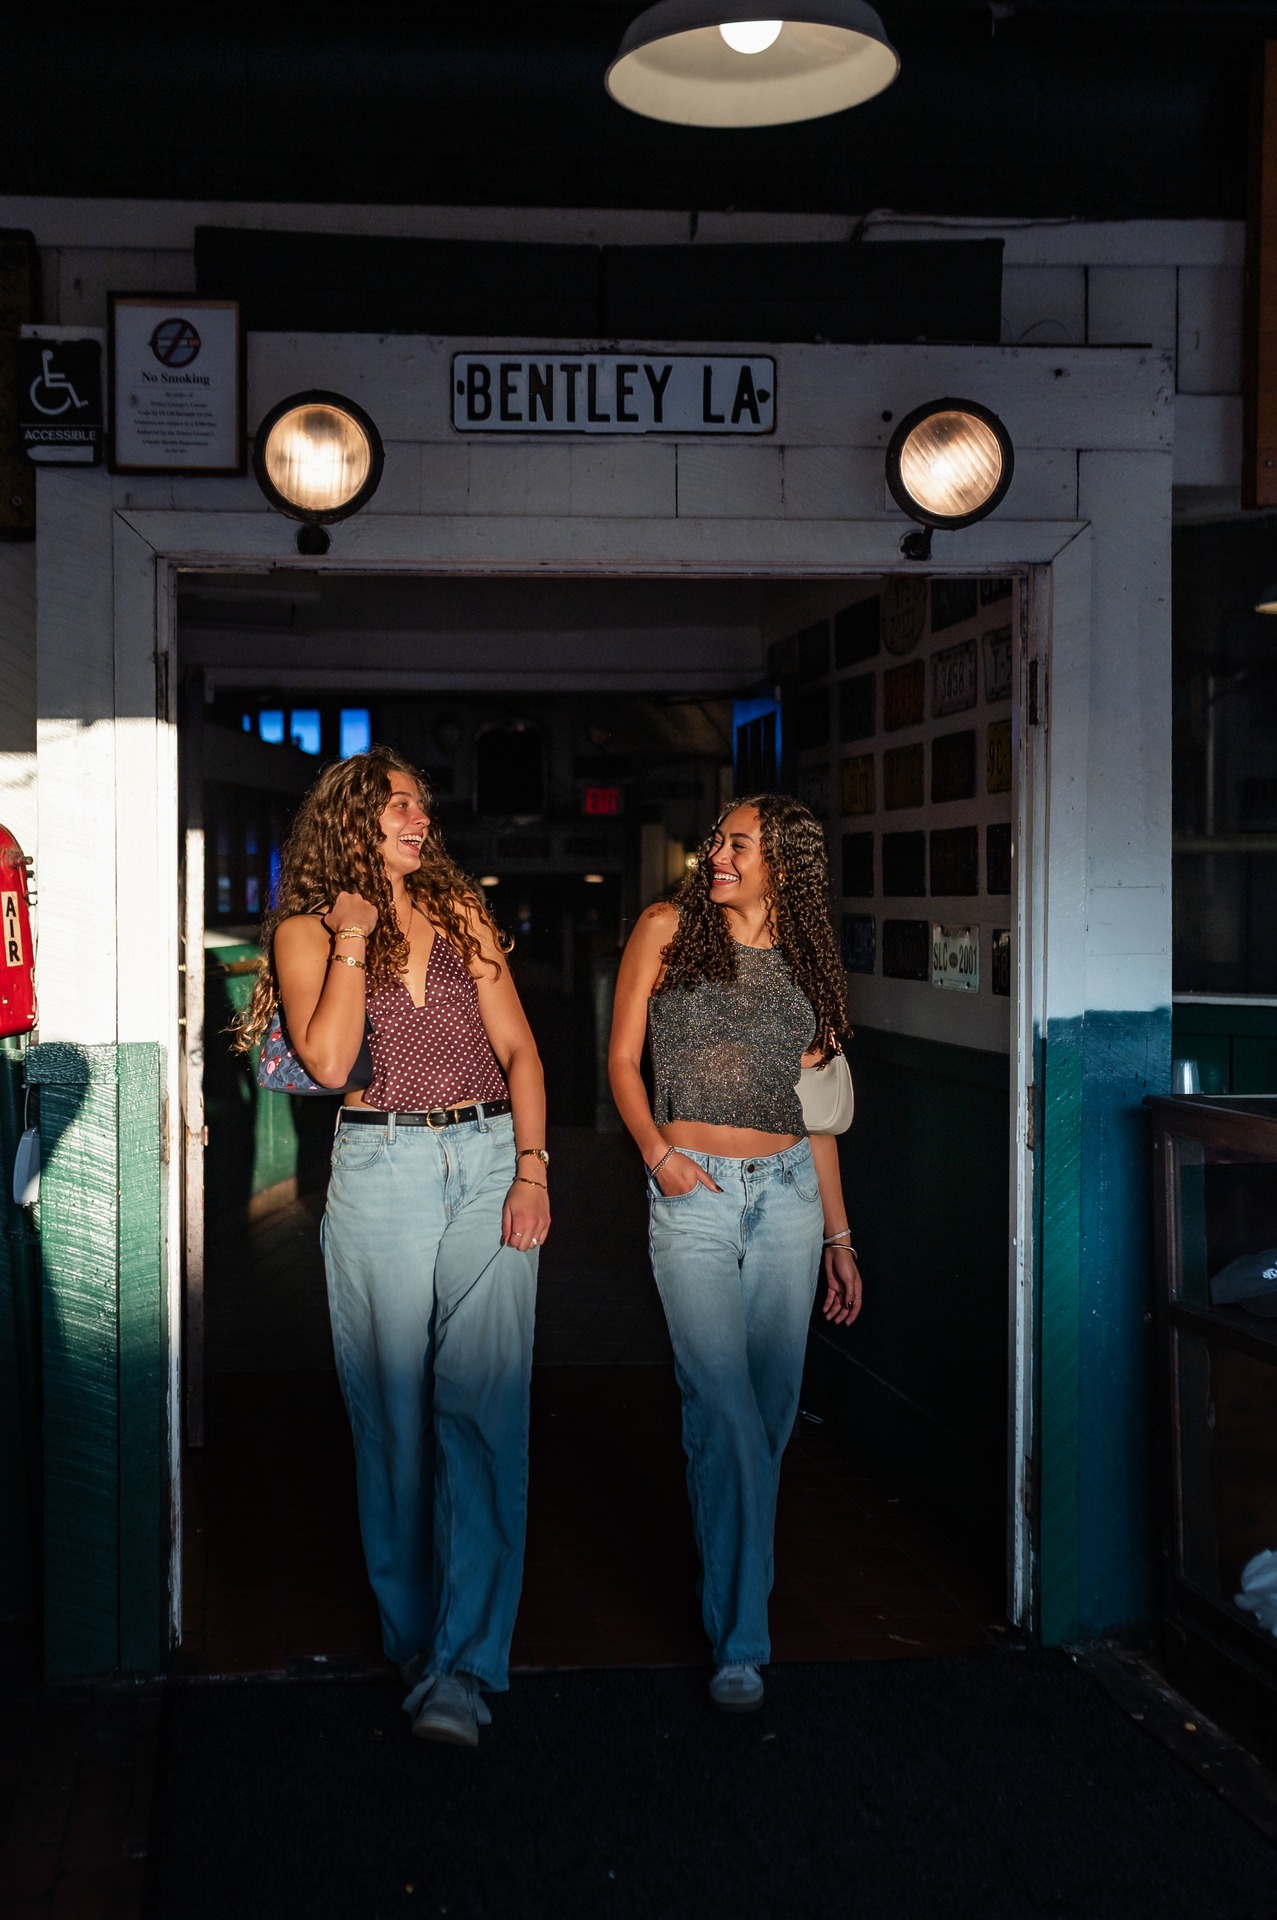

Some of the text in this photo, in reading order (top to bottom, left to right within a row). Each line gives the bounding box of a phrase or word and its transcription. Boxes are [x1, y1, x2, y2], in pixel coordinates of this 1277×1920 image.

[141, 371, 211, 387] No Smoking
[467, 363, 761, 424] BENTLEY LA
[23, 429, 97, 441] ACCESSIBLE
[5, 896, 21, 962] AIR
[933, 941, 948, 972] SLC
[958, 944, 977, 976] 2001
